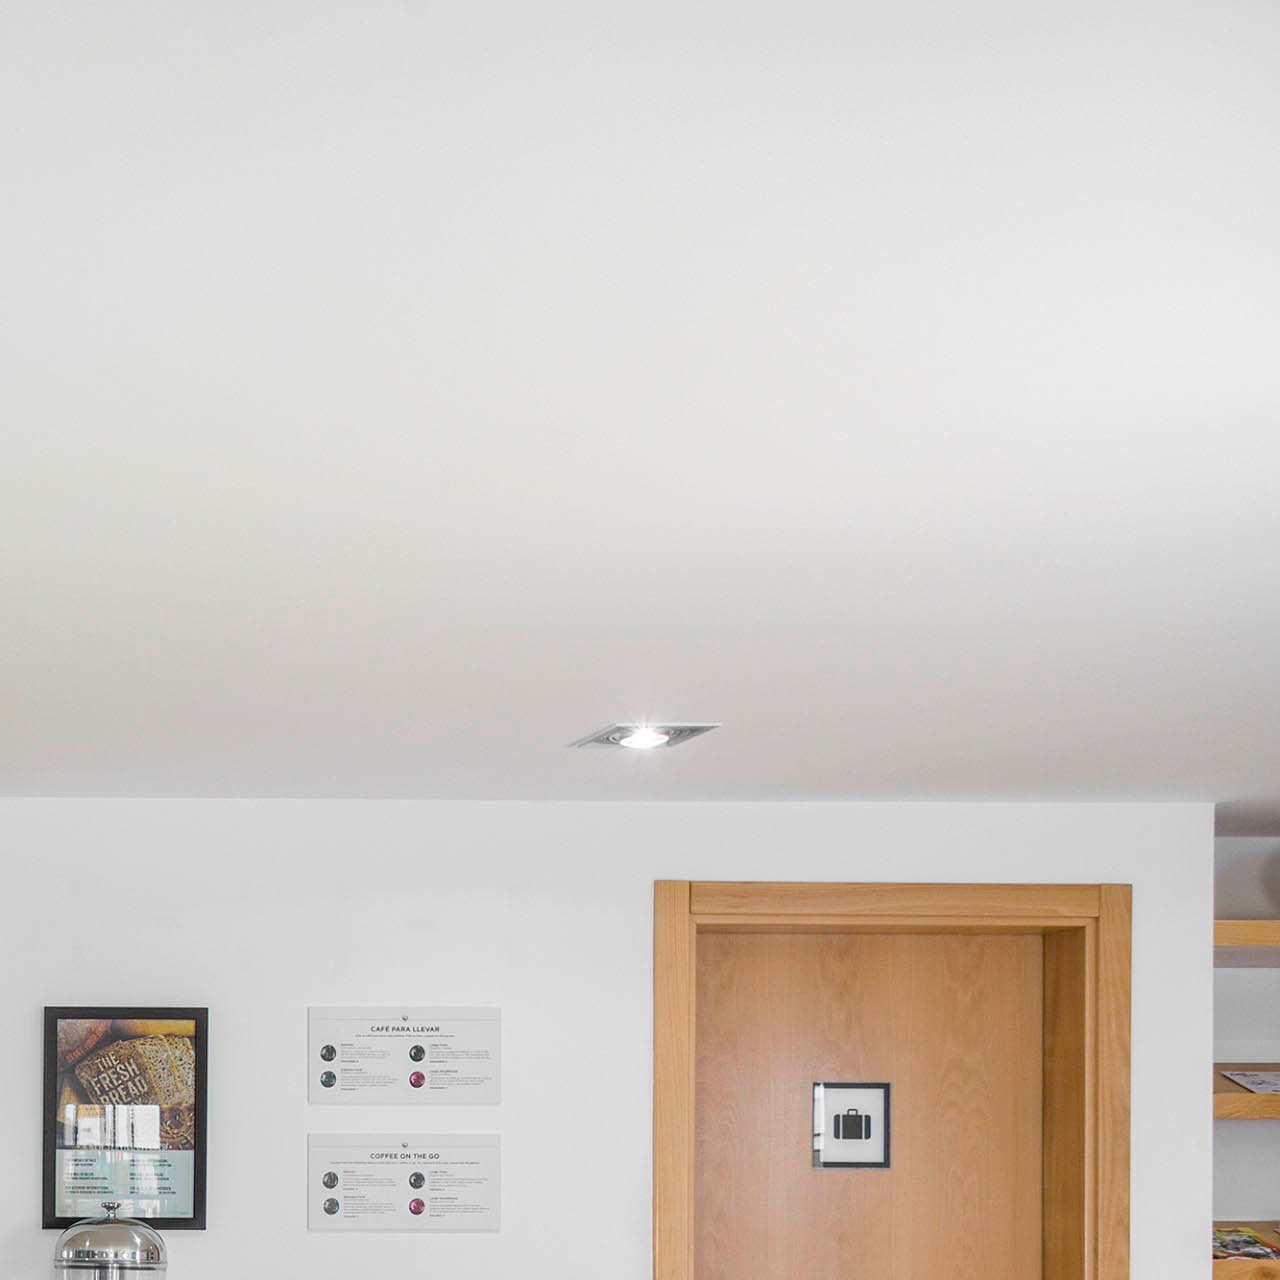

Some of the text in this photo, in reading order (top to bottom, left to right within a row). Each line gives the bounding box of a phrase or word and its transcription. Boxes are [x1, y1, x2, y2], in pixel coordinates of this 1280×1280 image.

[370, 1025, 390, 1033] CAFÉ
[95, 1051, 121, 1071] THE
[90, 1058, 141, 1095] FRESH
